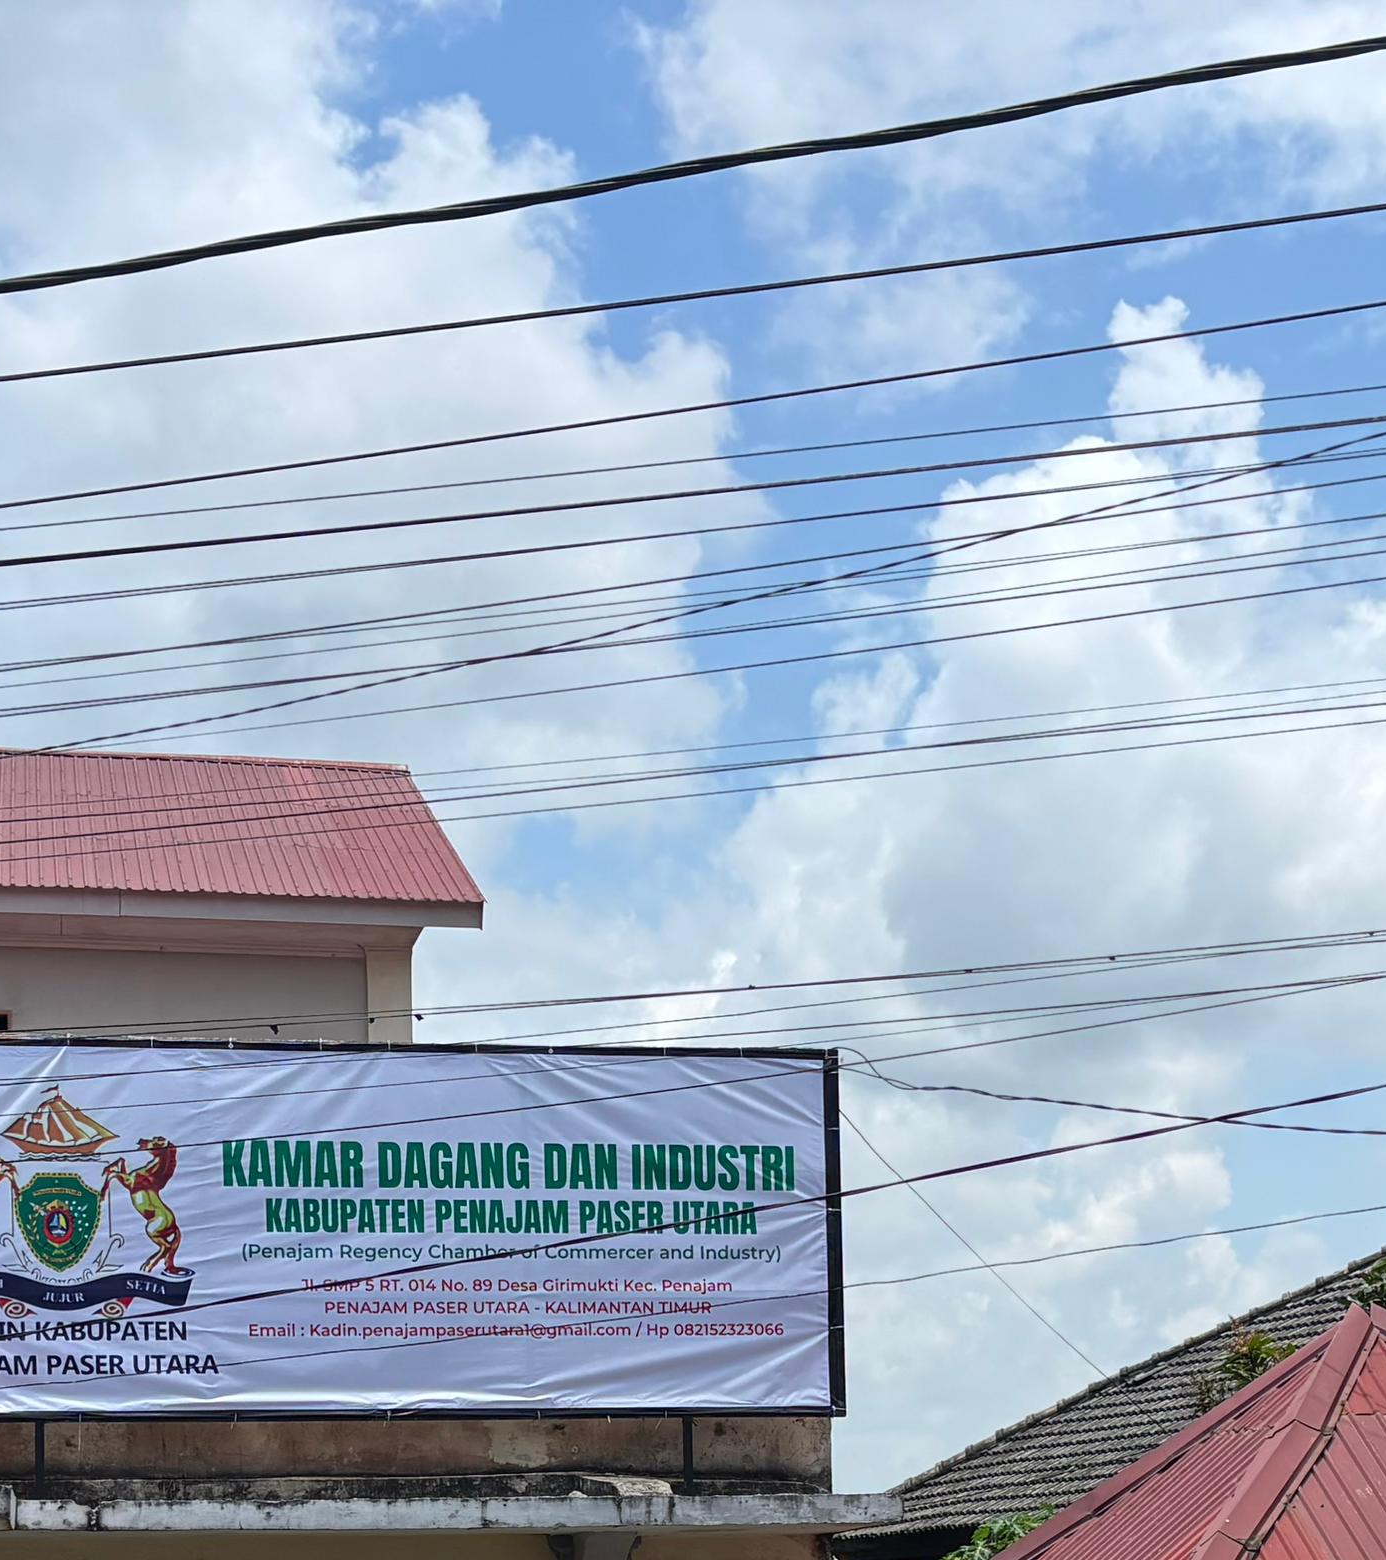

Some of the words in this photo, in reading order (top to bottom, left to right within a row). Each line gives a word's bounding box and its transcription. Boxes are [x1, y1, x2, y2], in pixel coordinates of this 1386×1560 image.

[221, 1140, 364, 1188] KAMAR
[377, 1141, 530, 1189] DAGANG
[543, 1143, 618, 1190] DAN
[631, 1144, 796, 1192] INDUSTRI
[265, 1198, 425, 1233] KABUPATEN
[435, 1199, 569, 1234] PENAJAM
[579, 1200, 664, 1234] PASER
[673, 1201, 758, 1235] UTARA
[241, 1243, 333, 1262] (Penajam
[339, 1244, 423, 1263] Regency
[428, 1243, 513, 1260] Chamber
[521, 1245, 539, 1260] of
[544, 1246, 654, 1260] Commercer
[659, 1245, 694, 1260] and
[700, 1245, 782, 1263] Industry)
[126, 1280, 166, 1295] SETIA
[323, 1279, 360, 1292] SMP
[365, 1280, 375, 1292] 5
[380, 1279, 404, 1292] RT.
[408, 1279, 437, 1292] 014
[441, 1279, 468, 1292] No.
[472, 1279, 493, 1292] 89
[497, 1279, 538, 1292] Desa
[542, 1279, 619, 1292] Girimukti
[623, 1279, 657, 1292] Kec.
[662, 1280, 733, 1295] Penajam
[43, 1291, 85, 1303] JUJUR
[324, 1301, 408, 1314] PENAJAM
[413, 1301, 469, 1314] PASER
[473, 1301, 530, 1314] UTARA
[545, 1301, 654, 1314] KALIMANTAN
[659, 1301, 712, 1314] TIMUR
[35, 1321, 188, 1341] KABUPATEN
[248, 1323, 296, 1337] Email
[635, 1322, 643, 1338] /
[646, 1323, 670, 1339] Hp
[673, 1323, 784, 1337] 082152323066
[46, 1355, 126, 1375] PASER
[132, 1355, 220, 1374] UTARA
